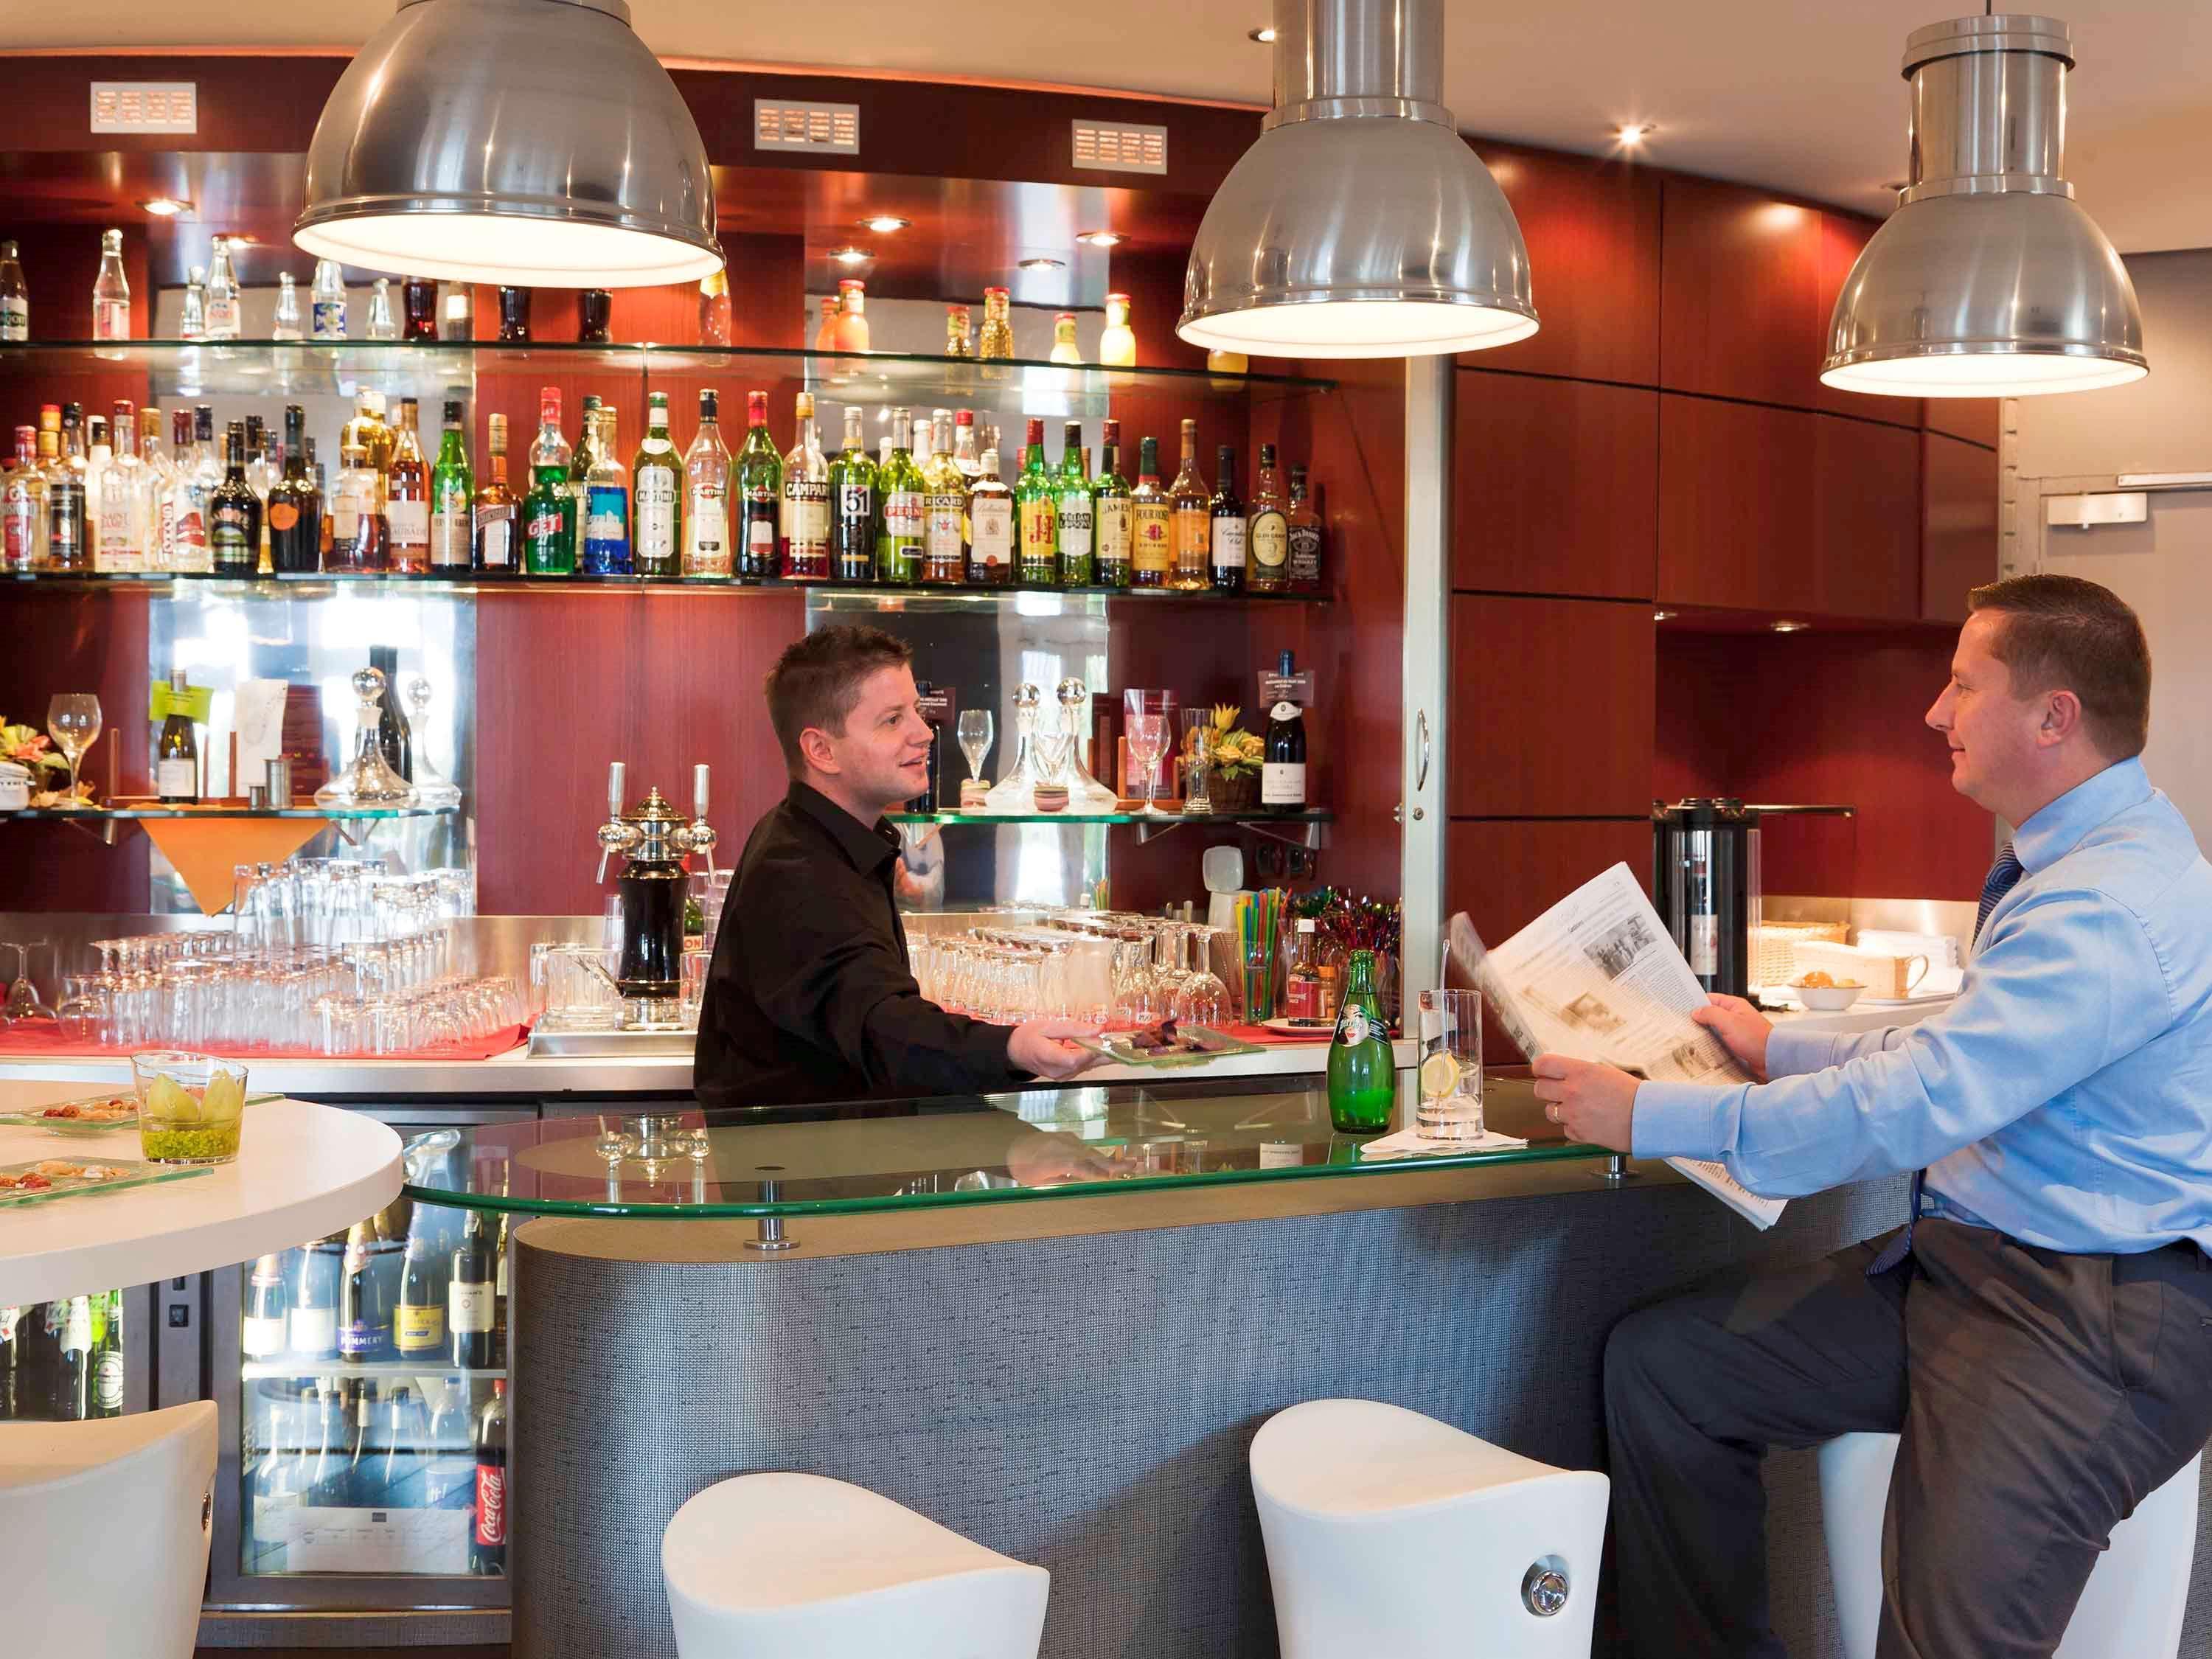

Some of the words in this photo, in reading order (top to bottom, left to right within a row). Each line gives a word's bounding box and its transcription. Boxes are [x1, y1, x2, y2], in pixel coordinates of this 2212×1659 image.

[692, 488, 726, 496] MARTINI
[846, 489, 868, 512] 51
[925, 496, 963, 507] RICARD
[886, 507, 922, 517] PERN
[1102, 502, 1131, 514] JAMES
[528, 513, 559, 537] GET
[340, 1335, 383, 1346] POMMERY
[481, 1469, 502, 1543] Coca-Cola
